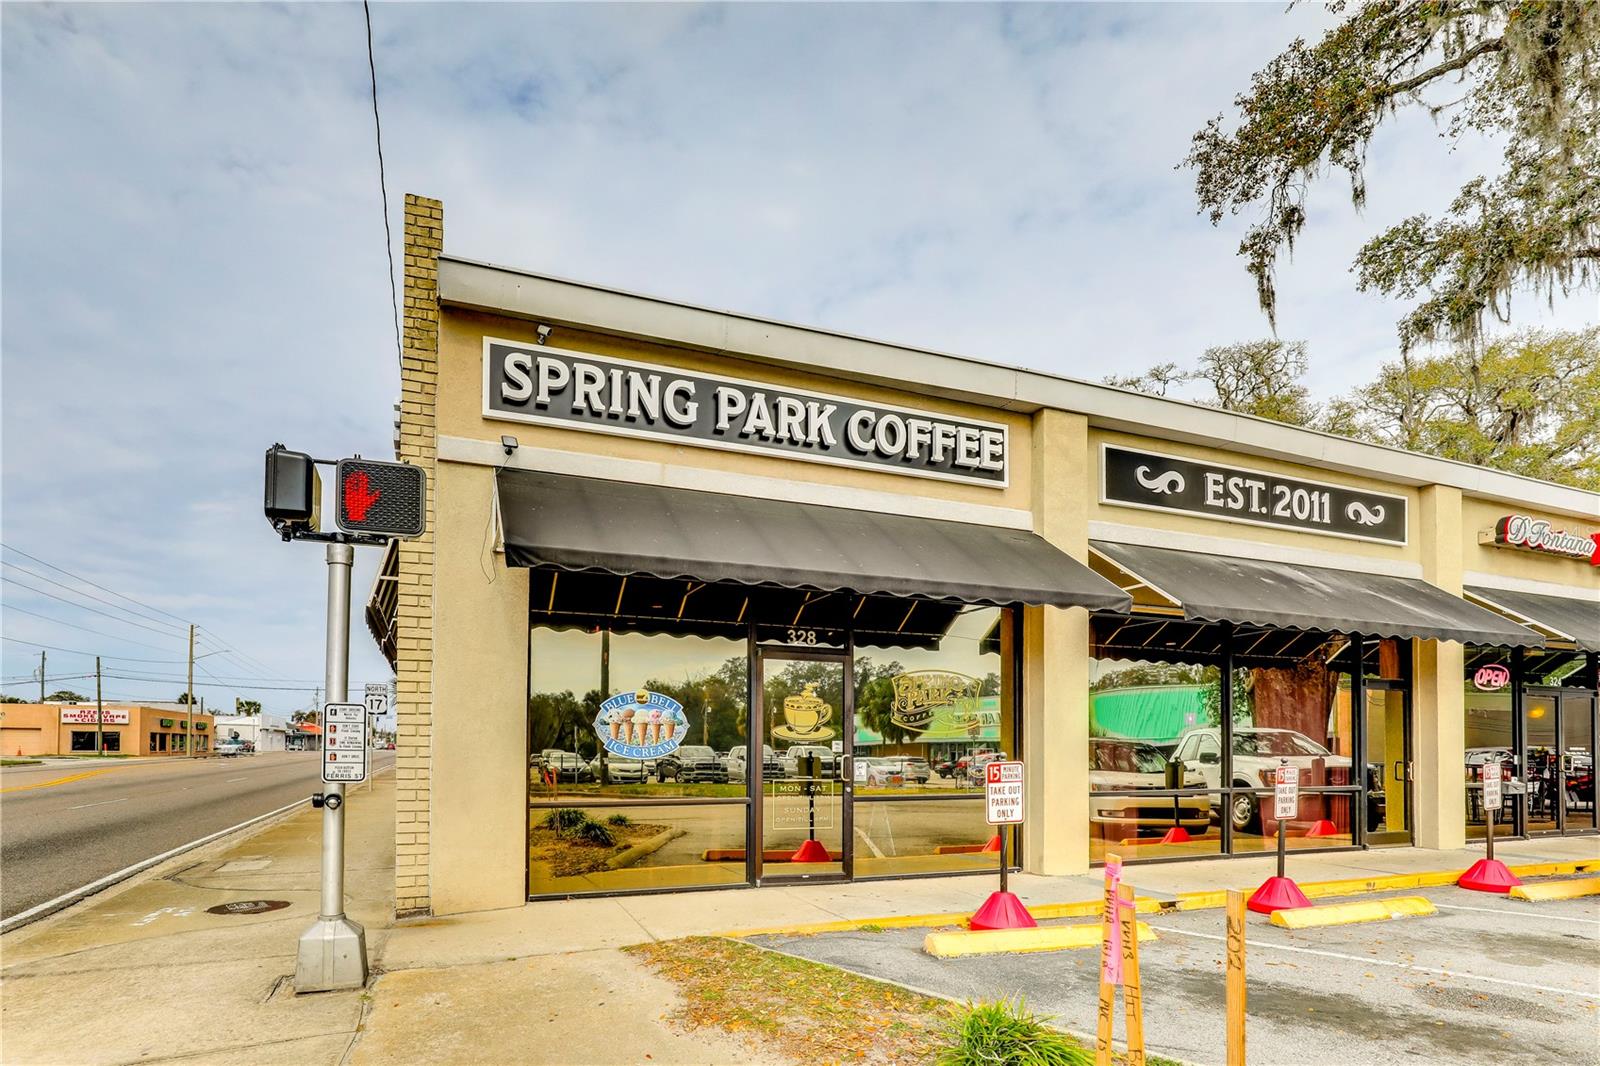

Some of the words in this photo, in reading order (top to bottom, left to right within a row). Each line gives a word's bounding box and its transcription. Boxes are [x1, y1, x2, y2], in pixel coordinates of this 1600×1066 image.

[500, 351, 698, 427] SPRING
[715, 385, 838, 447] PARK
[847, 408, 1004, 472] COFFEE
[1203, 471, 1268, 514] EST.
[1273, 485, 1332, 524] 2011
[786, 629, 817, 645] 328
[1477, 668, 1507, 687] OPEN
[1549, 676, 1561, 686] 324
[369, 699, 383, 710] 17
[605, 694, 635, 711] BLUE
[651, 694, 677, 712] BELL
[609, 740, 630, 756] ICE
[632, 740, 676, 757] CREAM
[989, 766, 1000, 781] 15
[990, 786, 1006, 795] TAKE
[1008, 785, 1021, 794] OUT
[991, 797, 1020, 807] PARKING
[997, 809, 1015, 818] ONLY
